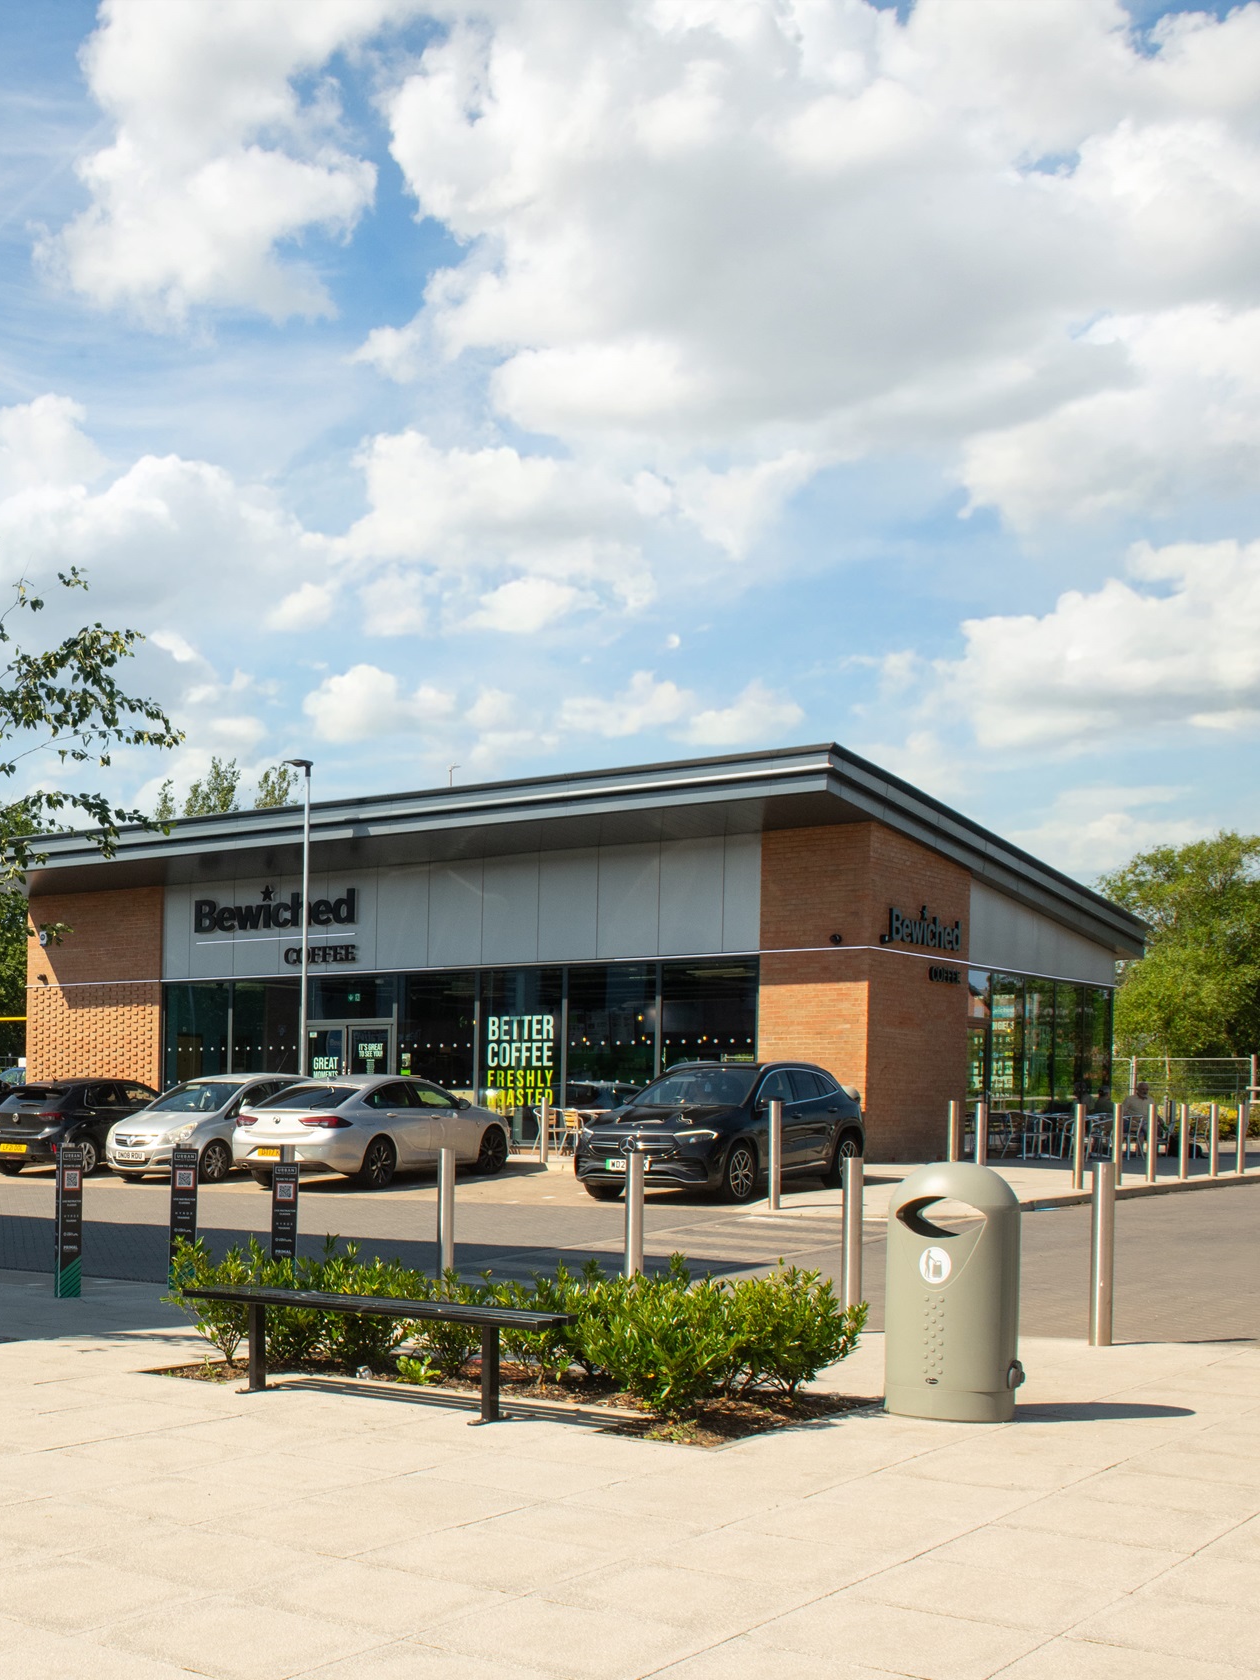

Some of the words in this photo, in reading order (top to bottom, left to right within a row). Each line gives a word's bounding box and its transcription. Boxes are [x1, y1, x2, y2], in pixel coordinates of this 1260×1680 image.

[194, 886, 356, 933] Bewiched
[889, 906, 961, 951] Bewiched
[284, 944, 356, 964] COFFEE
[928, 966, 961, 984] COFFEE
[487, 1014, 554, 1040] BETTER
[313, 1057, 338, 1070] GREAT
[487, 1041, 554, 1067] COFFEE
[487, 1069, 554, 1087] FRESHLY
